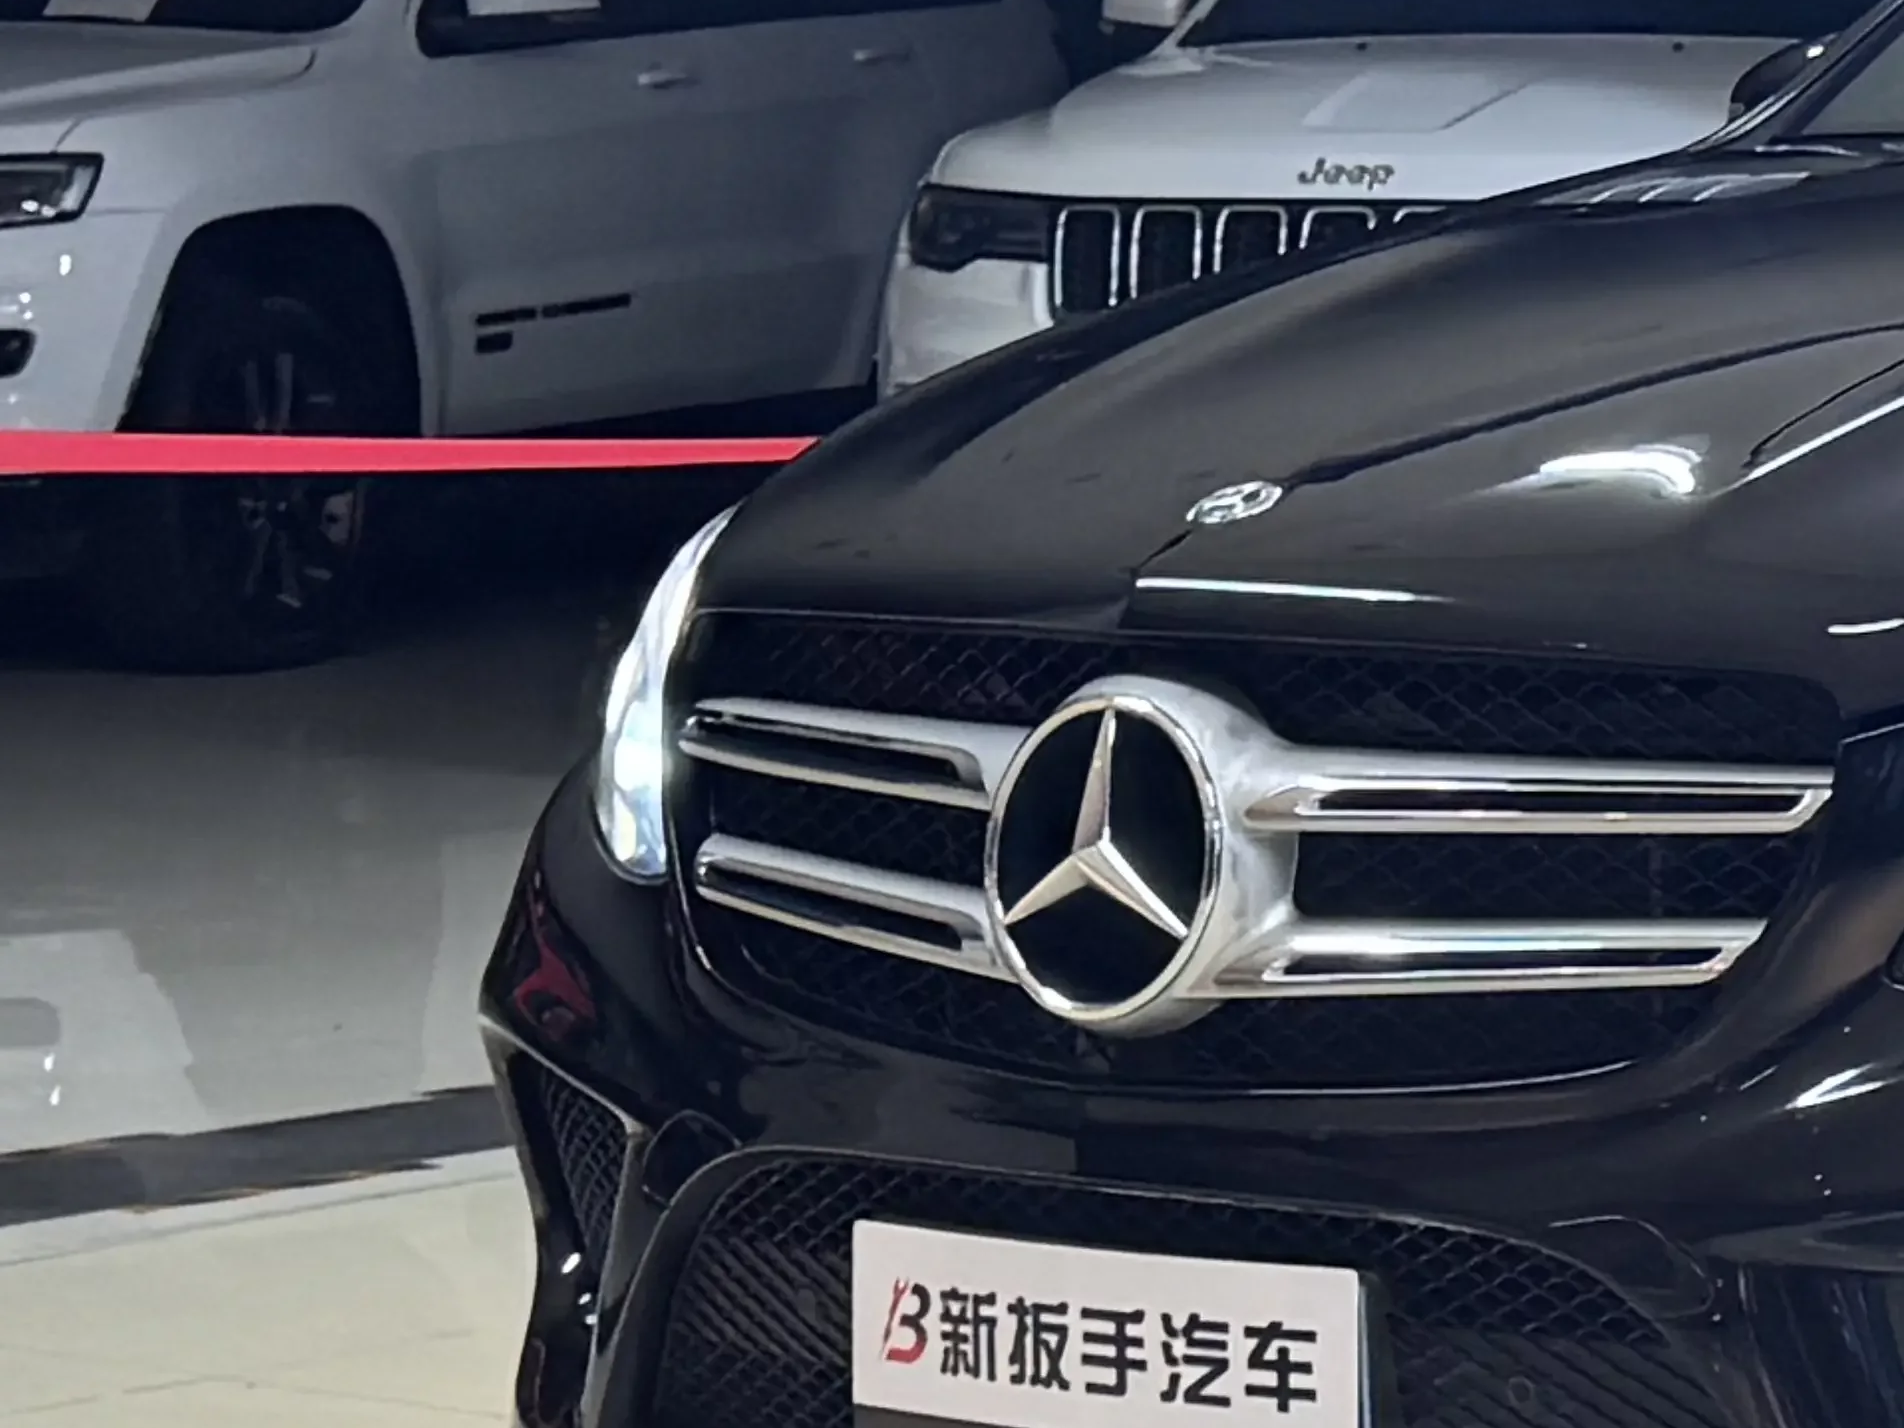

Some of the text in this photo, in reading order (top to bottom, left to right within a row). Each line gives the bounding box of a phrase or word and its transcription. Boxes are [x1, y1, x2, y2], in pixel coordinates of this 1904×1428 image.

[1297, 157, 1395, 190] Jeep
[939, 1286, 1319, 1413] 新扳手汽车
